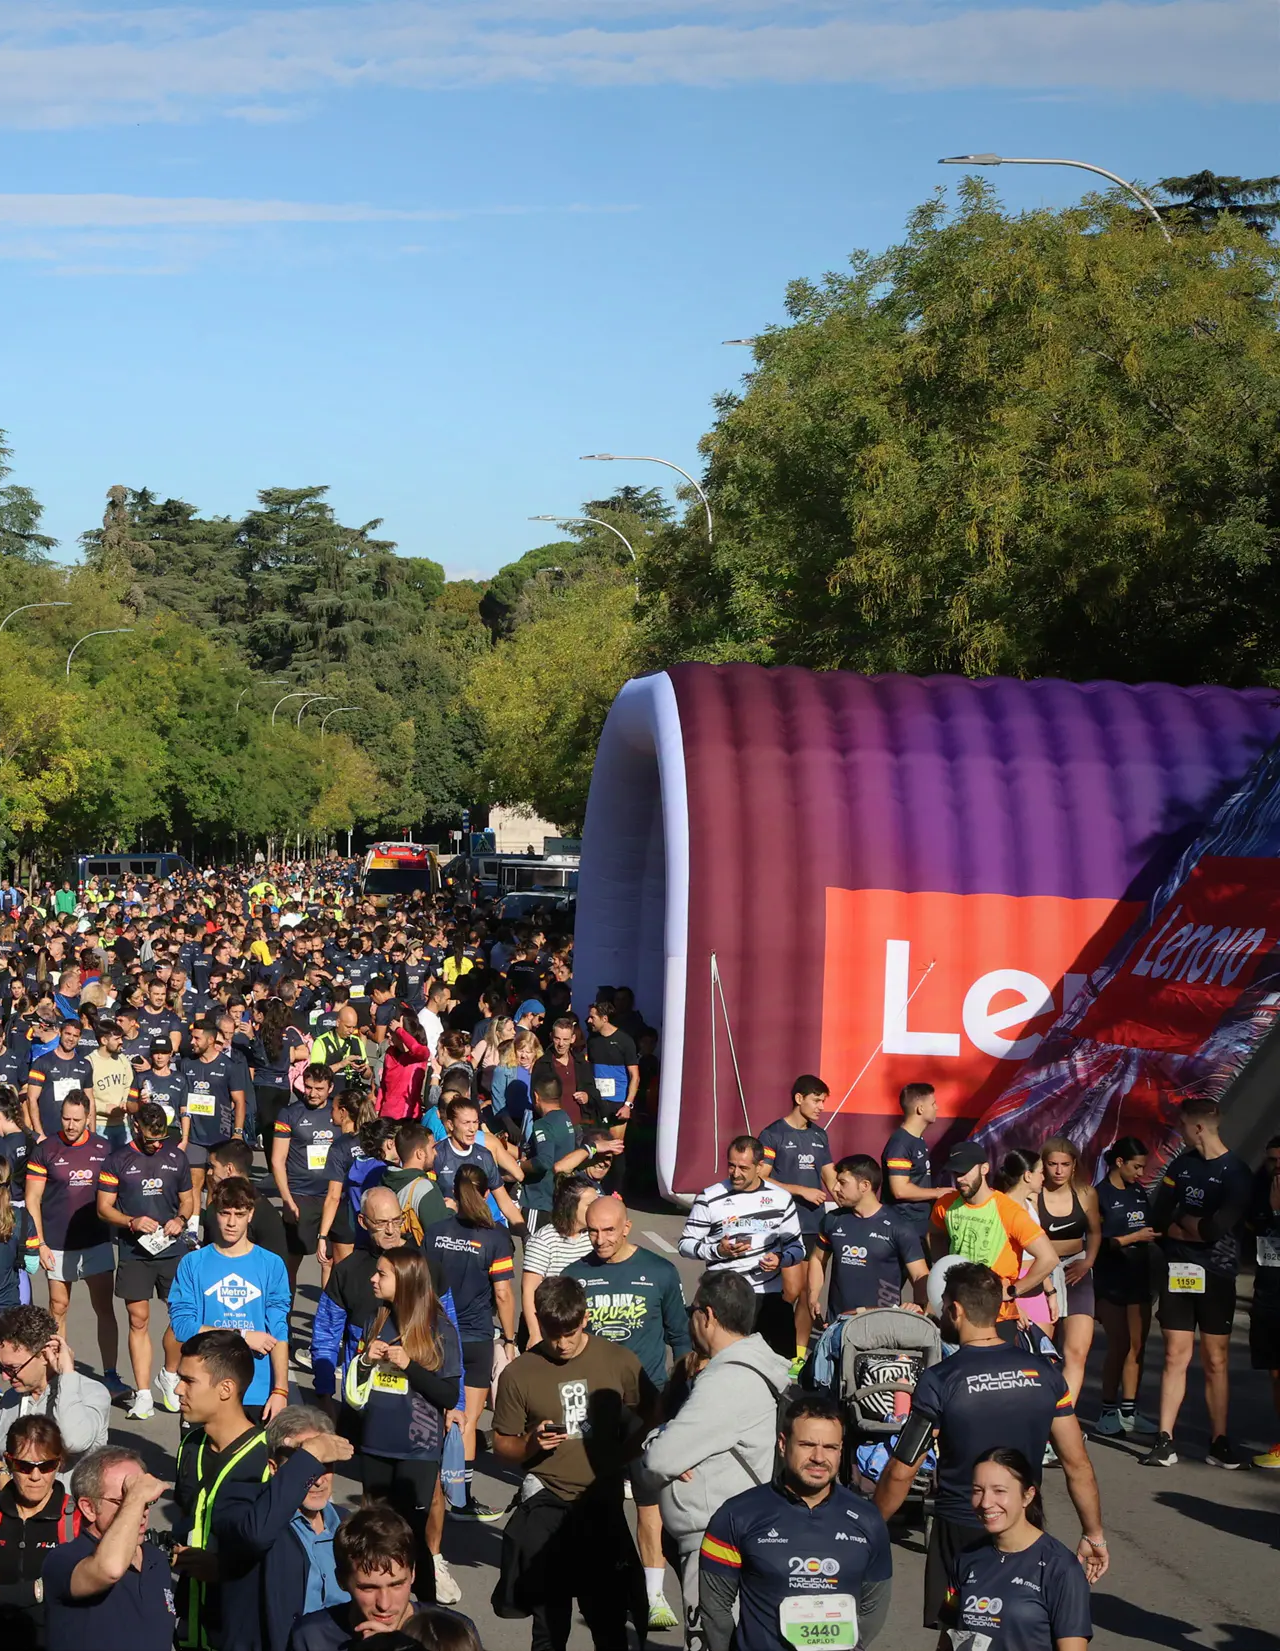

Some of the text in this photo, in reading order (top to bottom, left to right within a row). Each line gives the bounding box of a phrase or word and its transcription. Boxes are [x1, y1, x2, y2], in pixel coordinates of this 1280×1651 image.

[1132, 905, 1266, 986] Lenovo
[69, 1170, 93, 1180] 200
[142, 1179, 163, 1188] 200
[436, 1236, 470, 1245] POLICIA
[434, 1242, 479, 1254] NACIONAL
[842, 1245, 867, 1258] 200
[221, 1287, 246, 1296] Metro
[595, 1293, 634, 1307] NO HAY
[587, 1303, 648, 1322] EXCUSAS
[967, 1370, 1024, 1385] POLICIA
[561, 1383, 586, 1398] CO
[968, 1378, 1042, 1394] NACIONAL
[565, 1396, 586, 1409] LU
[788, 1556, 840, 1576] 200
[964, 1595, 1003, 1615] 200
[963, 1614, 992, 1622] POLICIA
[964, 1619, 1000, 1628] NACIONAL
[800, 1624, 840, 1637] 3440
